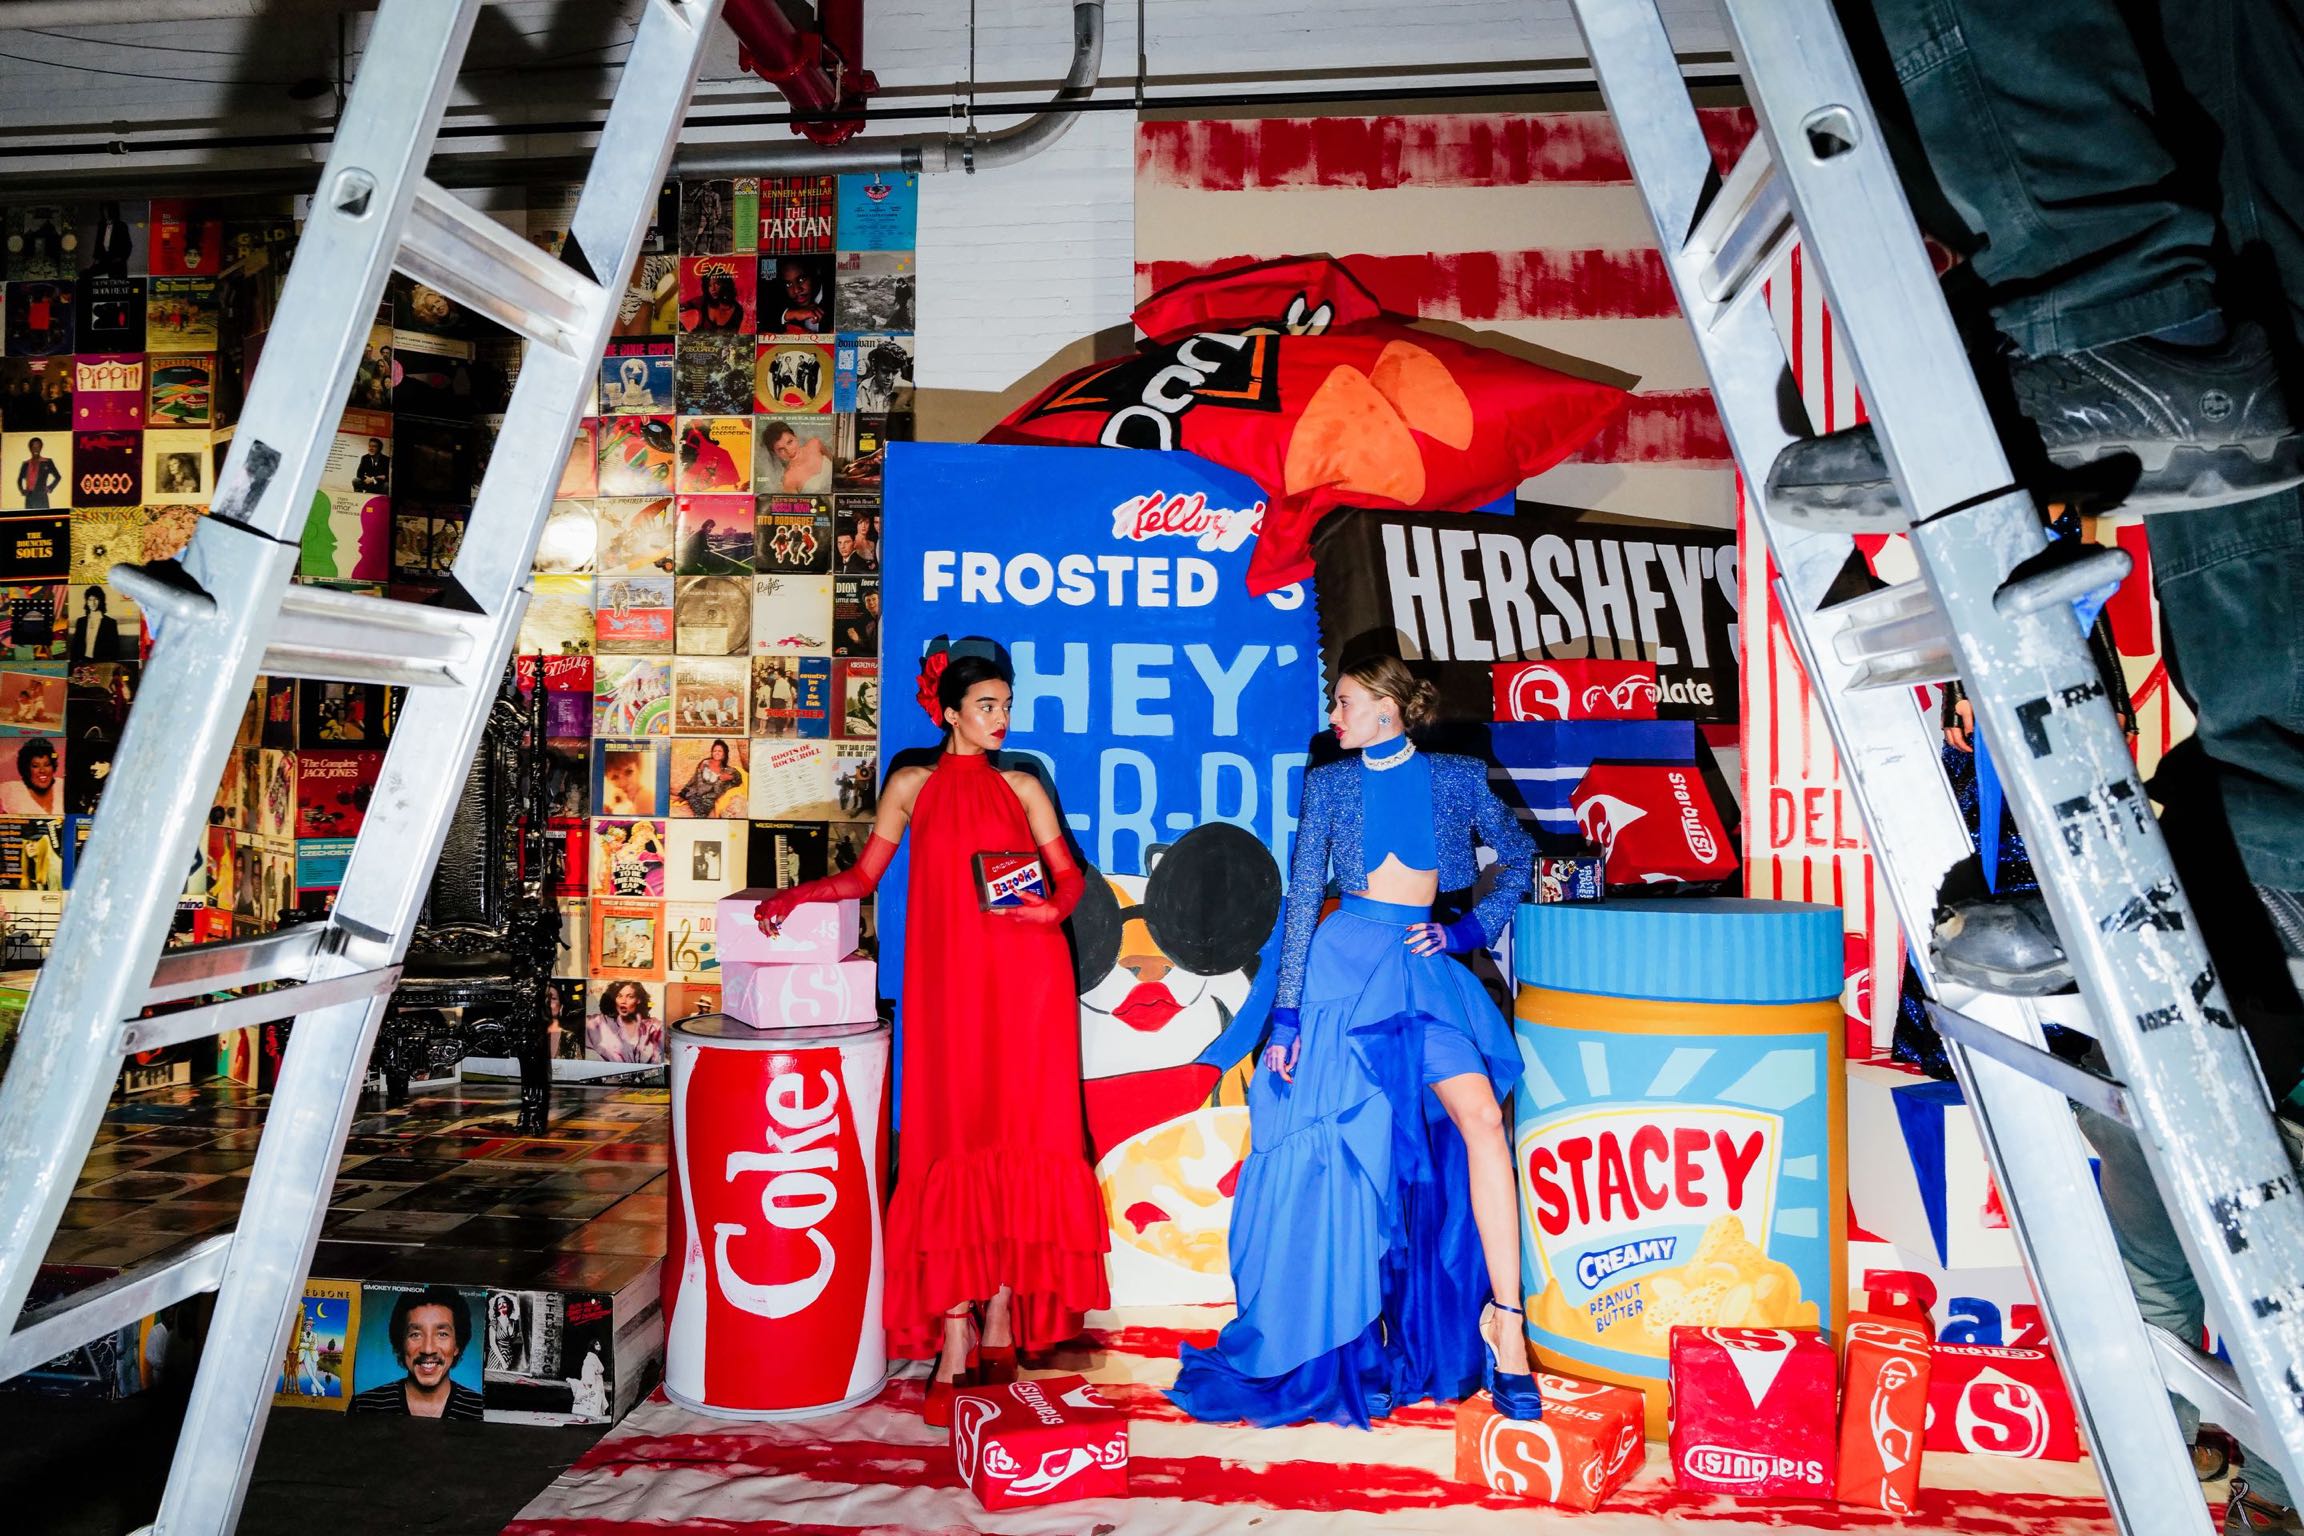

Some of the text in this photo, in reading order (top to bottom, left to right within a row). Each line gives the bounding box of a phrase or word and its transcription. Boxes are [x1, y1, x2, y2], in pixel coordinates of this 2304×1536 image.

[786, 207, 806, 219] THE
[760, 216, 832, 239] TARTAN
[15, 547, 54, 559] SOULS
[836, 582, 857, 593] DION
[923, 550, 1218, 608] FROSTED
[766, 708, 825, 718] TOGETHER
[300, 758, 358, 768] The Complete
[771, 746, 798, 762] ROOTS
[773, 747, 821, 769] ROCK ROLL
[300, 768, 359, 779] JACK JONES
[1668, 772, 1715, 863] Starburst
[992, 867, 1038, 897] Bazooka
[1530, 1125, 1764, 1236] STACEY
[713, 1068, 839, 1319] Coke
[1578, 1238, 1675, 1287] CREAMY
[363, 1284, 425, 1294] SMOKEY ROBINSON
[1590, 1283, 1641, 1316] PEANUT
[1596, 1299, 1643, 1333] BUTTER
[1697, 1450, 1823, 1485] Starburst
